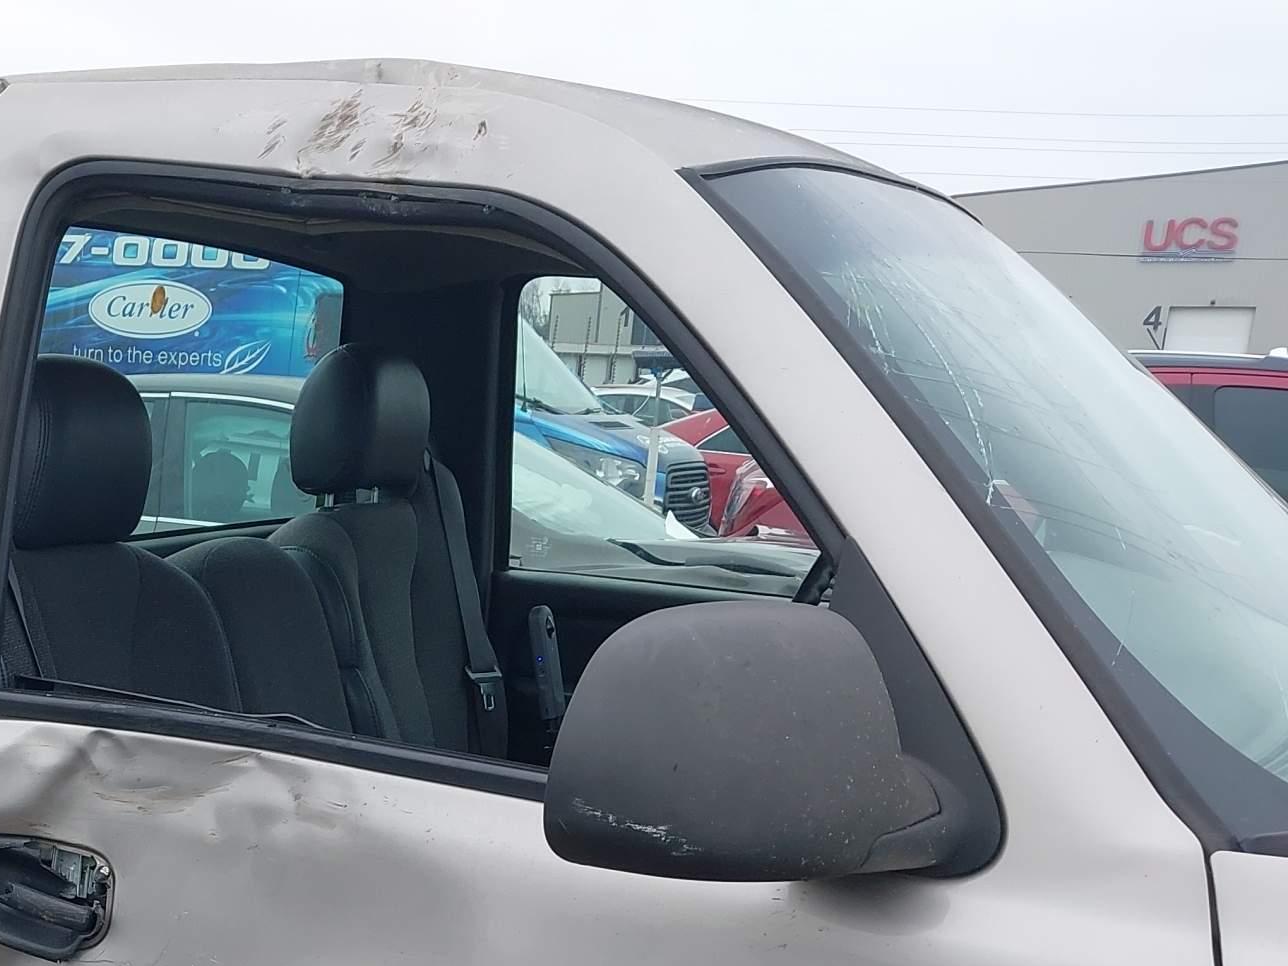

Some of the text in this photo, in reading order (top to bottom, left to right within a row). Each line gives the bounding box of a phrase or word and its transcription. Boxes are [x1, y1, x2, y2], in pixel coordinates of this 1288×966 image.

[1143, 217, 1239, 251] UCS
[1142, 305, 1163, 331] 4
[72, 345, 223, 369] turn to the experts
